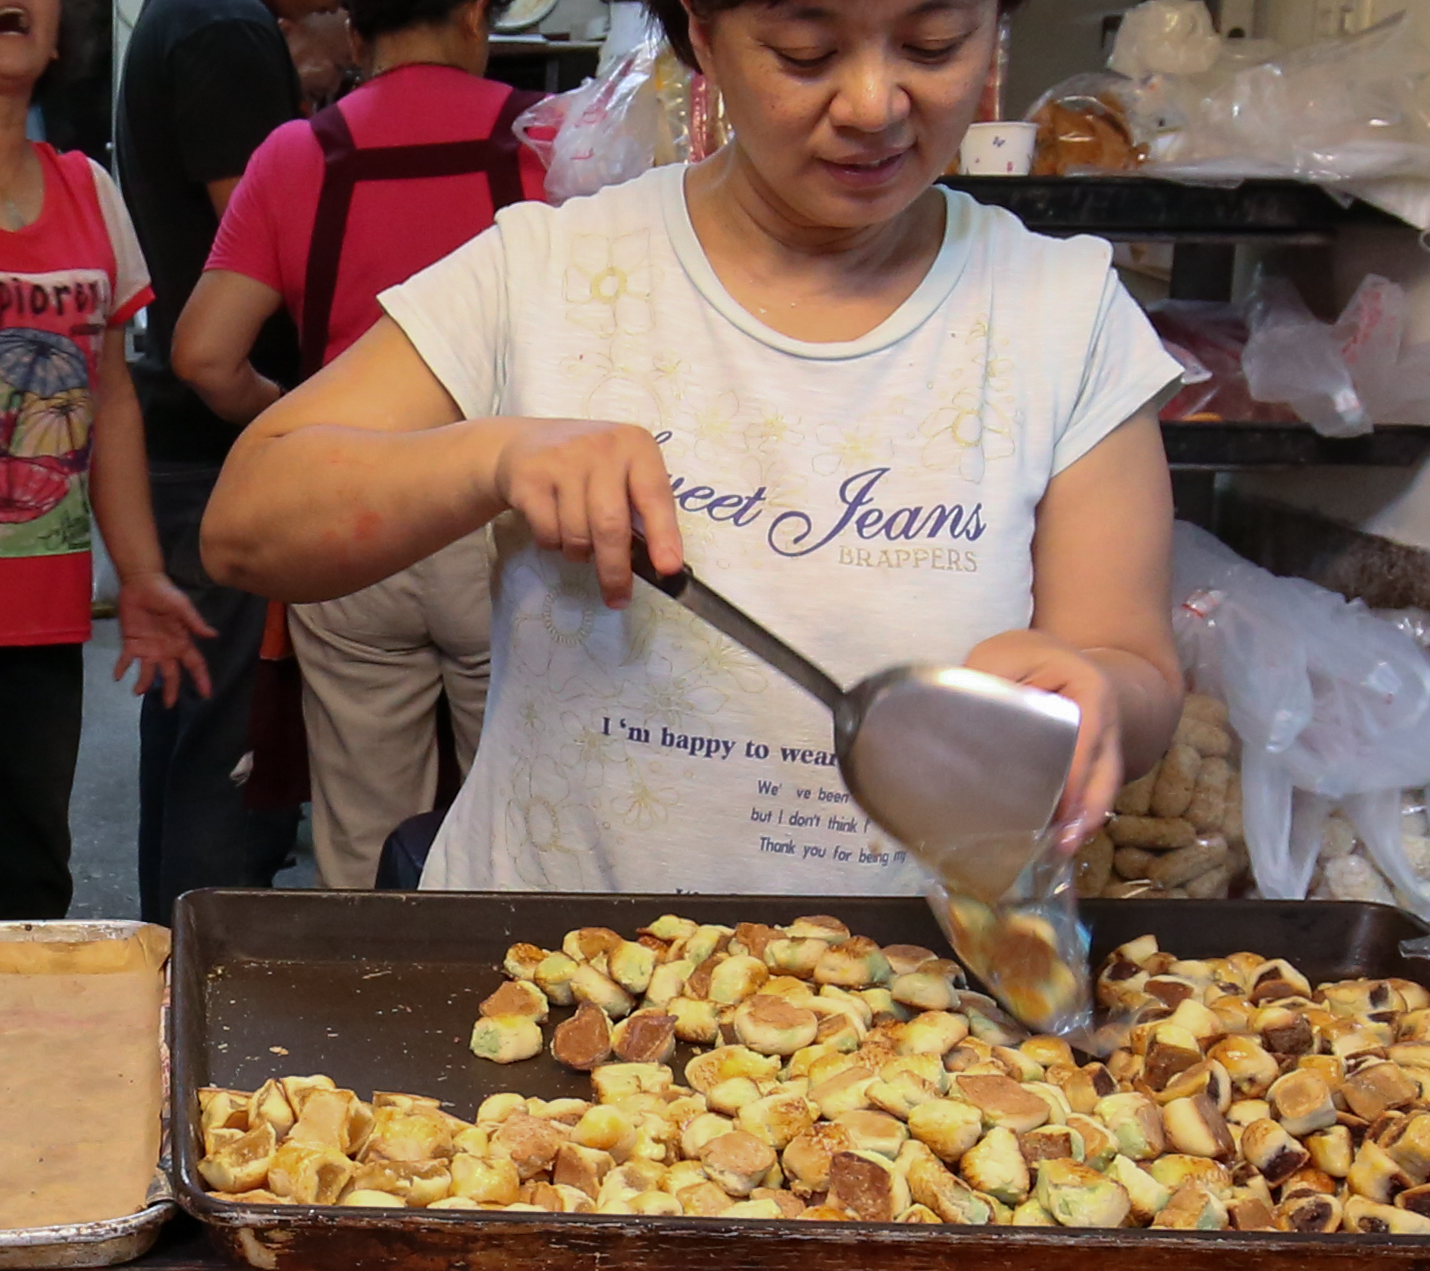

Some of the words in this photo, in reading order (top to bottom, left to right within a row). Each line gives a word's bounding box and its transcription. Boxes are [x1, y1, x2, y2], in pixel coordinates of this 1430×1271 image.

[768, 467, 988, 557] Jeans
[838, 544, 979, 573] BRAPPERS
[745, 740, 770, 760] to
[796, 786, 812, 800] ve
[817, 787, 850, 804] been
[750, 807, 773, 824] but
[788, 812, 821, 828] don't
[827, 816, 859, 833] think
[759, 836, 796, 855] Thank
[803, 843, 828, 861] you
[833, 844, 852, 862] for
[858, 847, 890, 867] being
